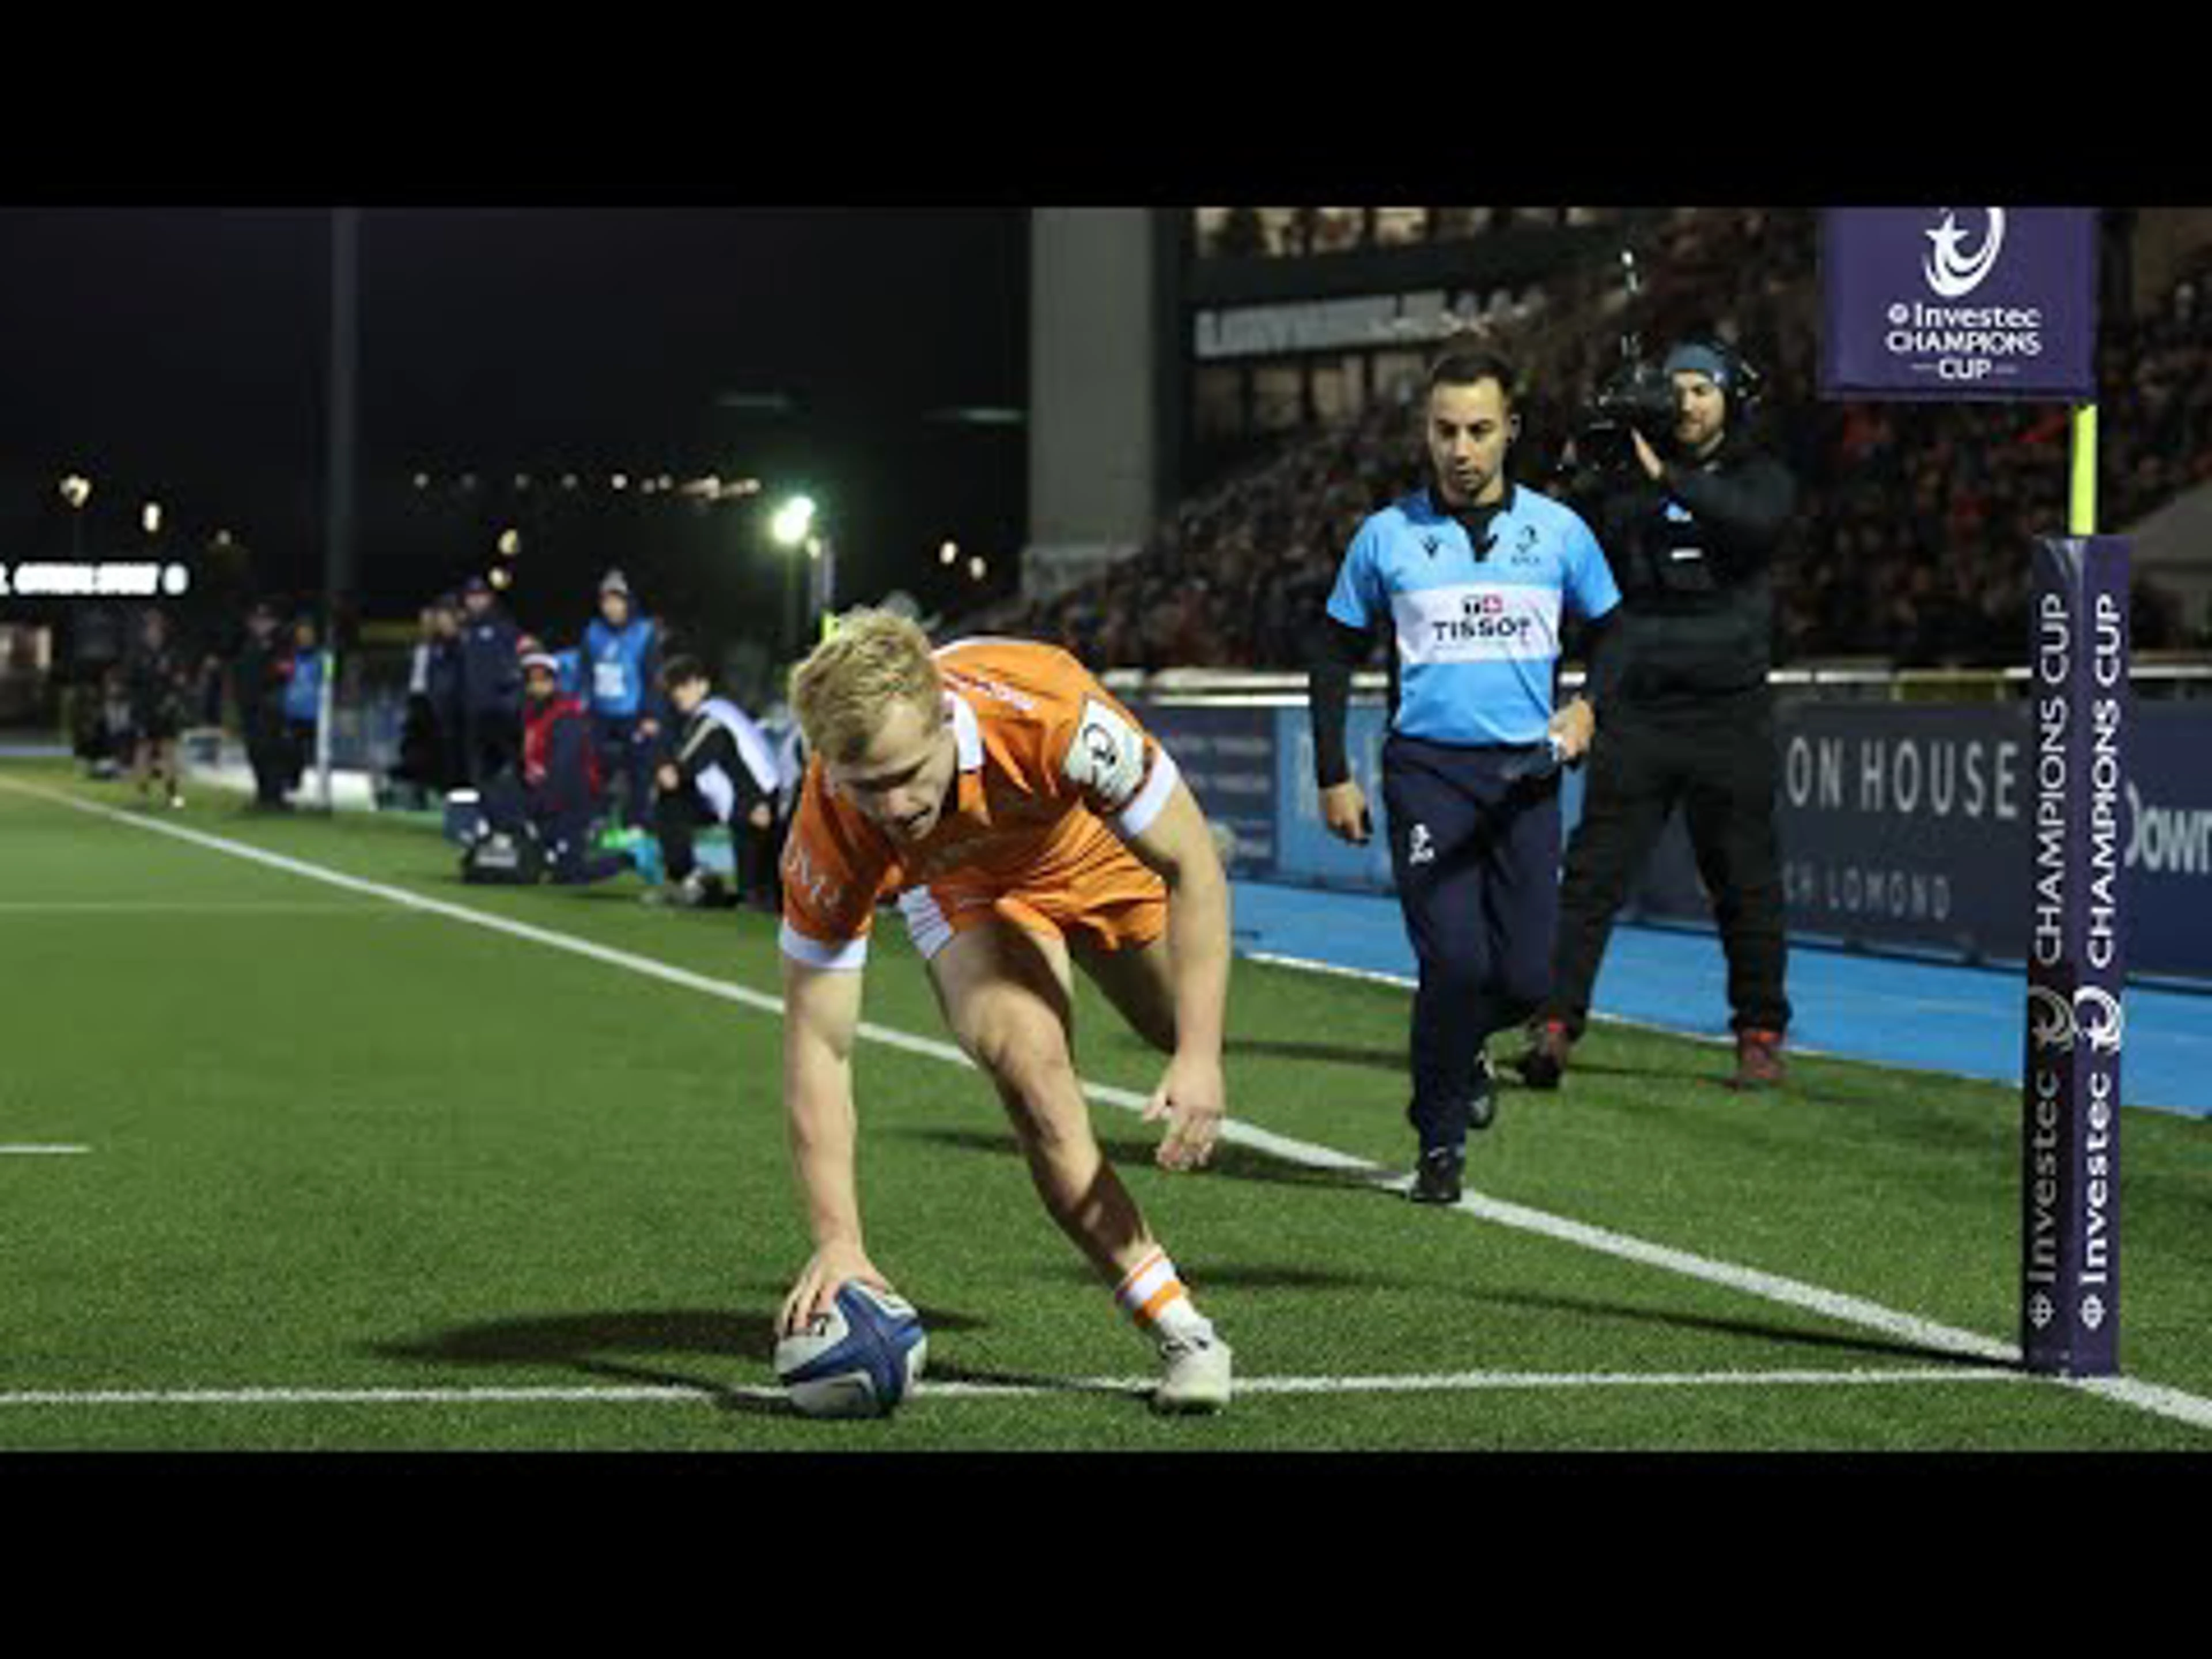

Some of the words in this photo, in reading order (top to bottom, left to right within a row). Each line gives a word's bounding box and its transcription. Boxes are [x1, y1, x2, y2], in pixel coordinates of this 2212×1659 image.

[1885, 331, 2042, 355] CHAMPIONS
[1914, 301, 2042, 328] Investec
[1937, 357, 1992, 380] CUP
[1431, 616, 1532, 643] TISSOT
[2040, 593, 2070, 685] CUP
[2094, 593, 2120, 687] CUP
[1860, 738, 2018, 818] HOUSE
[2035, 696, 2069, 964] CHAMPIONS
[2087, 699, 2120, 969] CHAMPIONS
[2027, 1071, 2060, 1284] Investec
[2079, 1071, 2111, 1284] Investec
